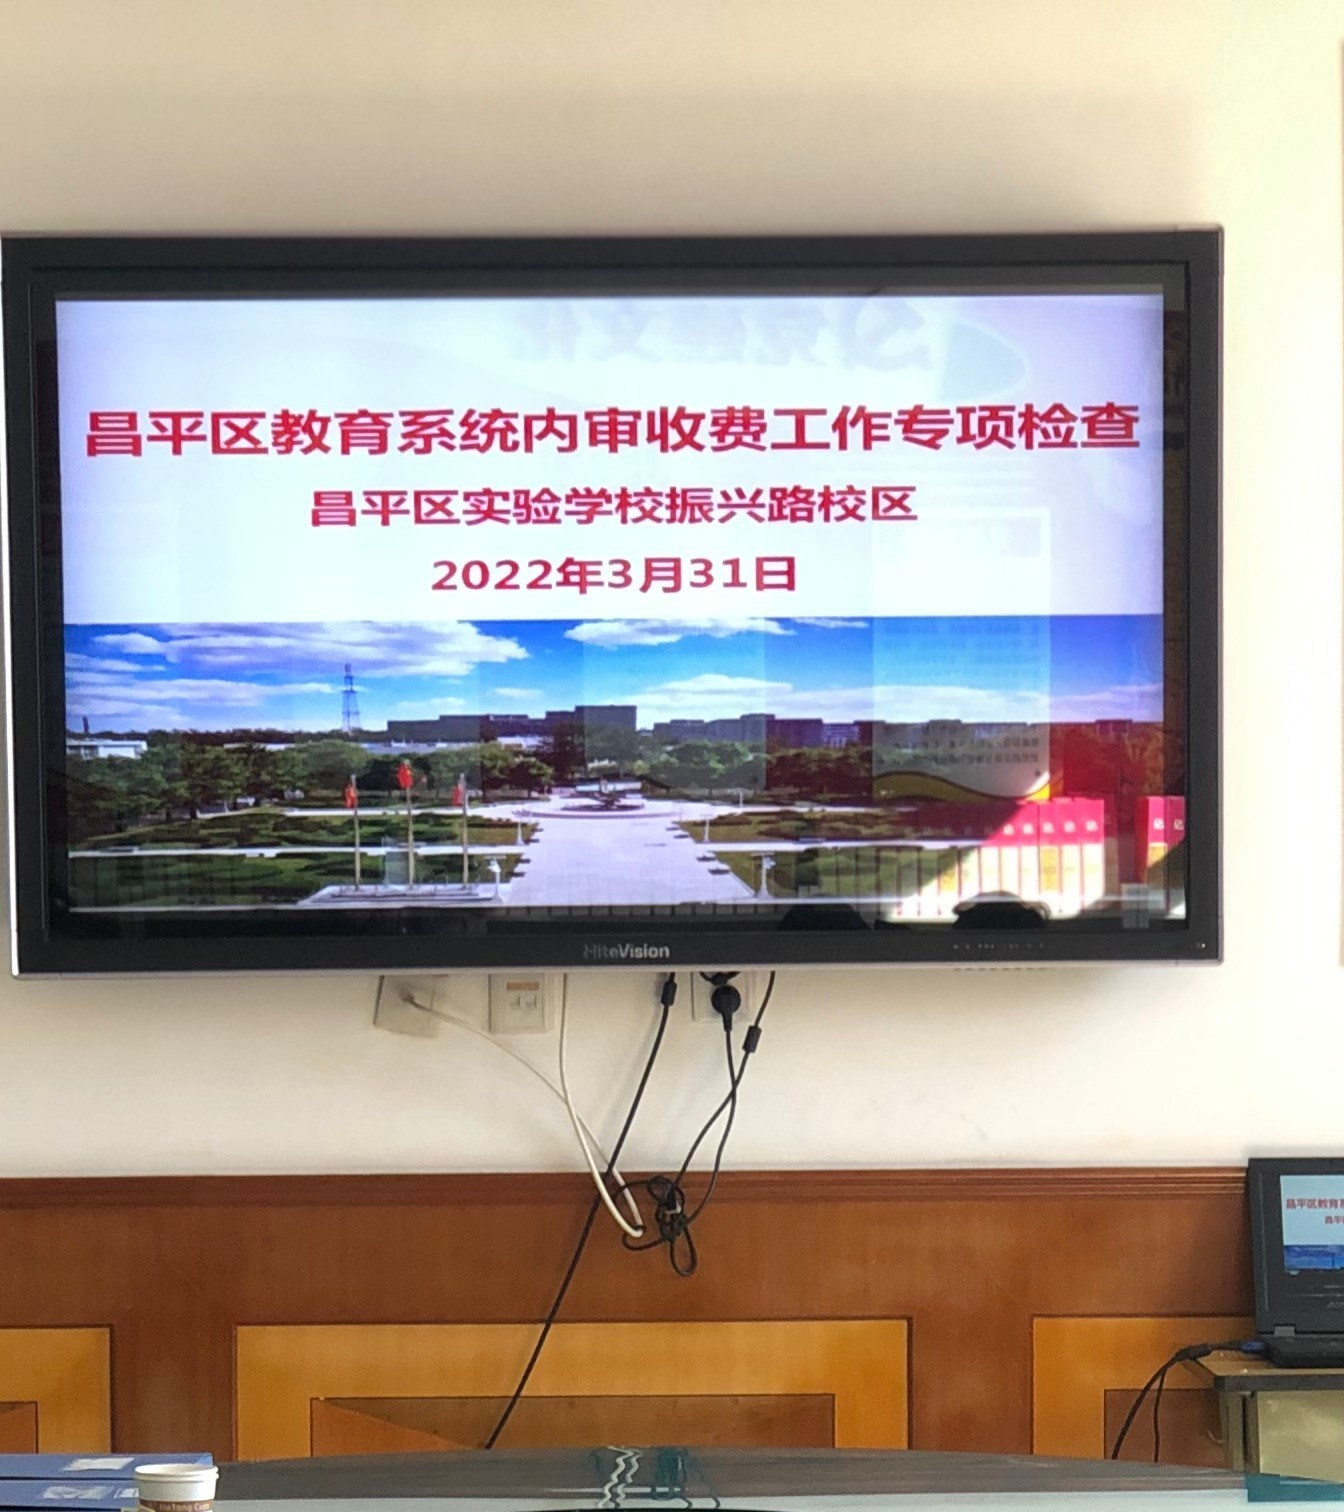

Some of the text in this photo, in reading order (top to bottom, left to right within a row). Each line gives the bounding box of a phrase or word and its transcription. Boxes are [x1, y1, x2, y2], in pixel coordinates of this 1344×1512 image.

[86, 403, 1140, 458] 昌平区教育系统内审收费工作专项检查
[311, 486, 917, 528] 昌平区实验学校振兴路校区
[431, 556, 795, 594] 2022年3月31日
